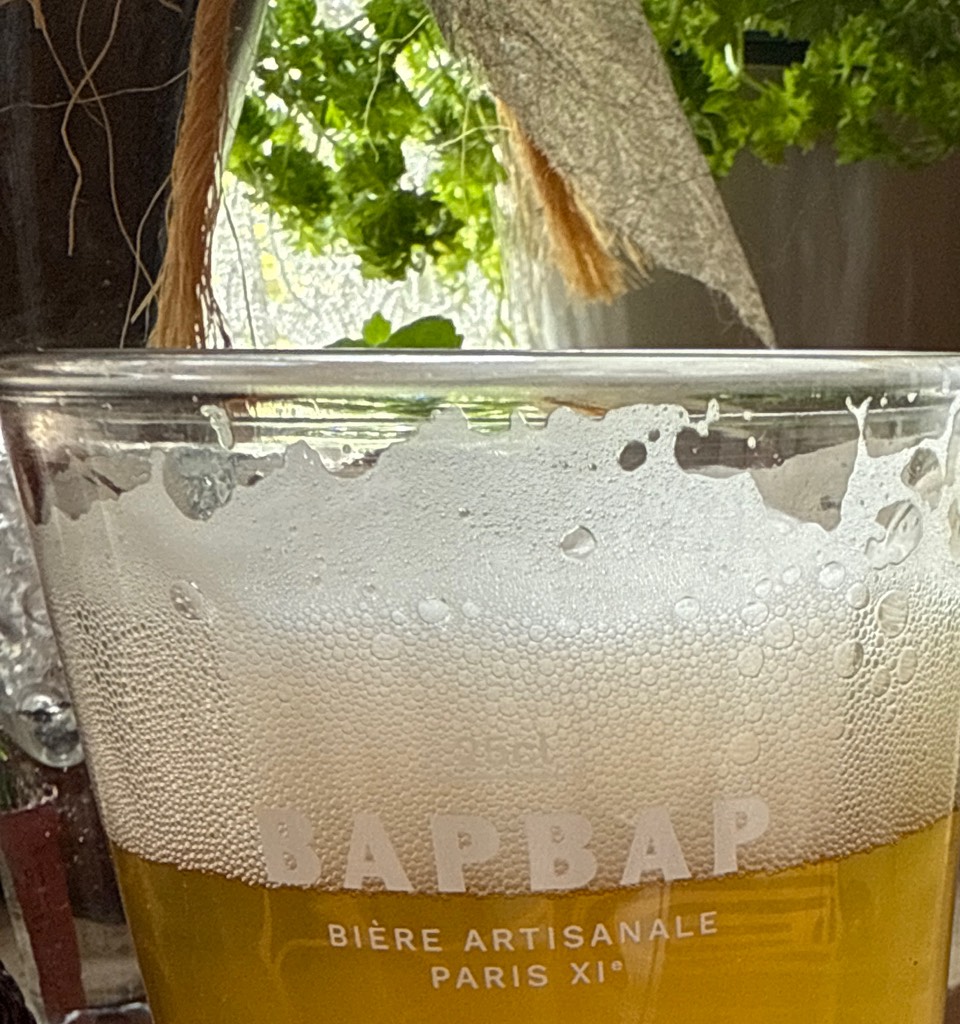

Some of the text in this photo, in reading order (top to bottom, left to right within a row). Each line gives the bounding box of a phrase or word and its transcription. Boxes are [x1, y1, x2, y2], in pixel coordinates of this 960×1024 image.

[256, 798, 770, 894] BAPBAP
[327, 911, 719, 953] BIÈRE ARTISANALE
[430, 964, 549, 990] PARIS
